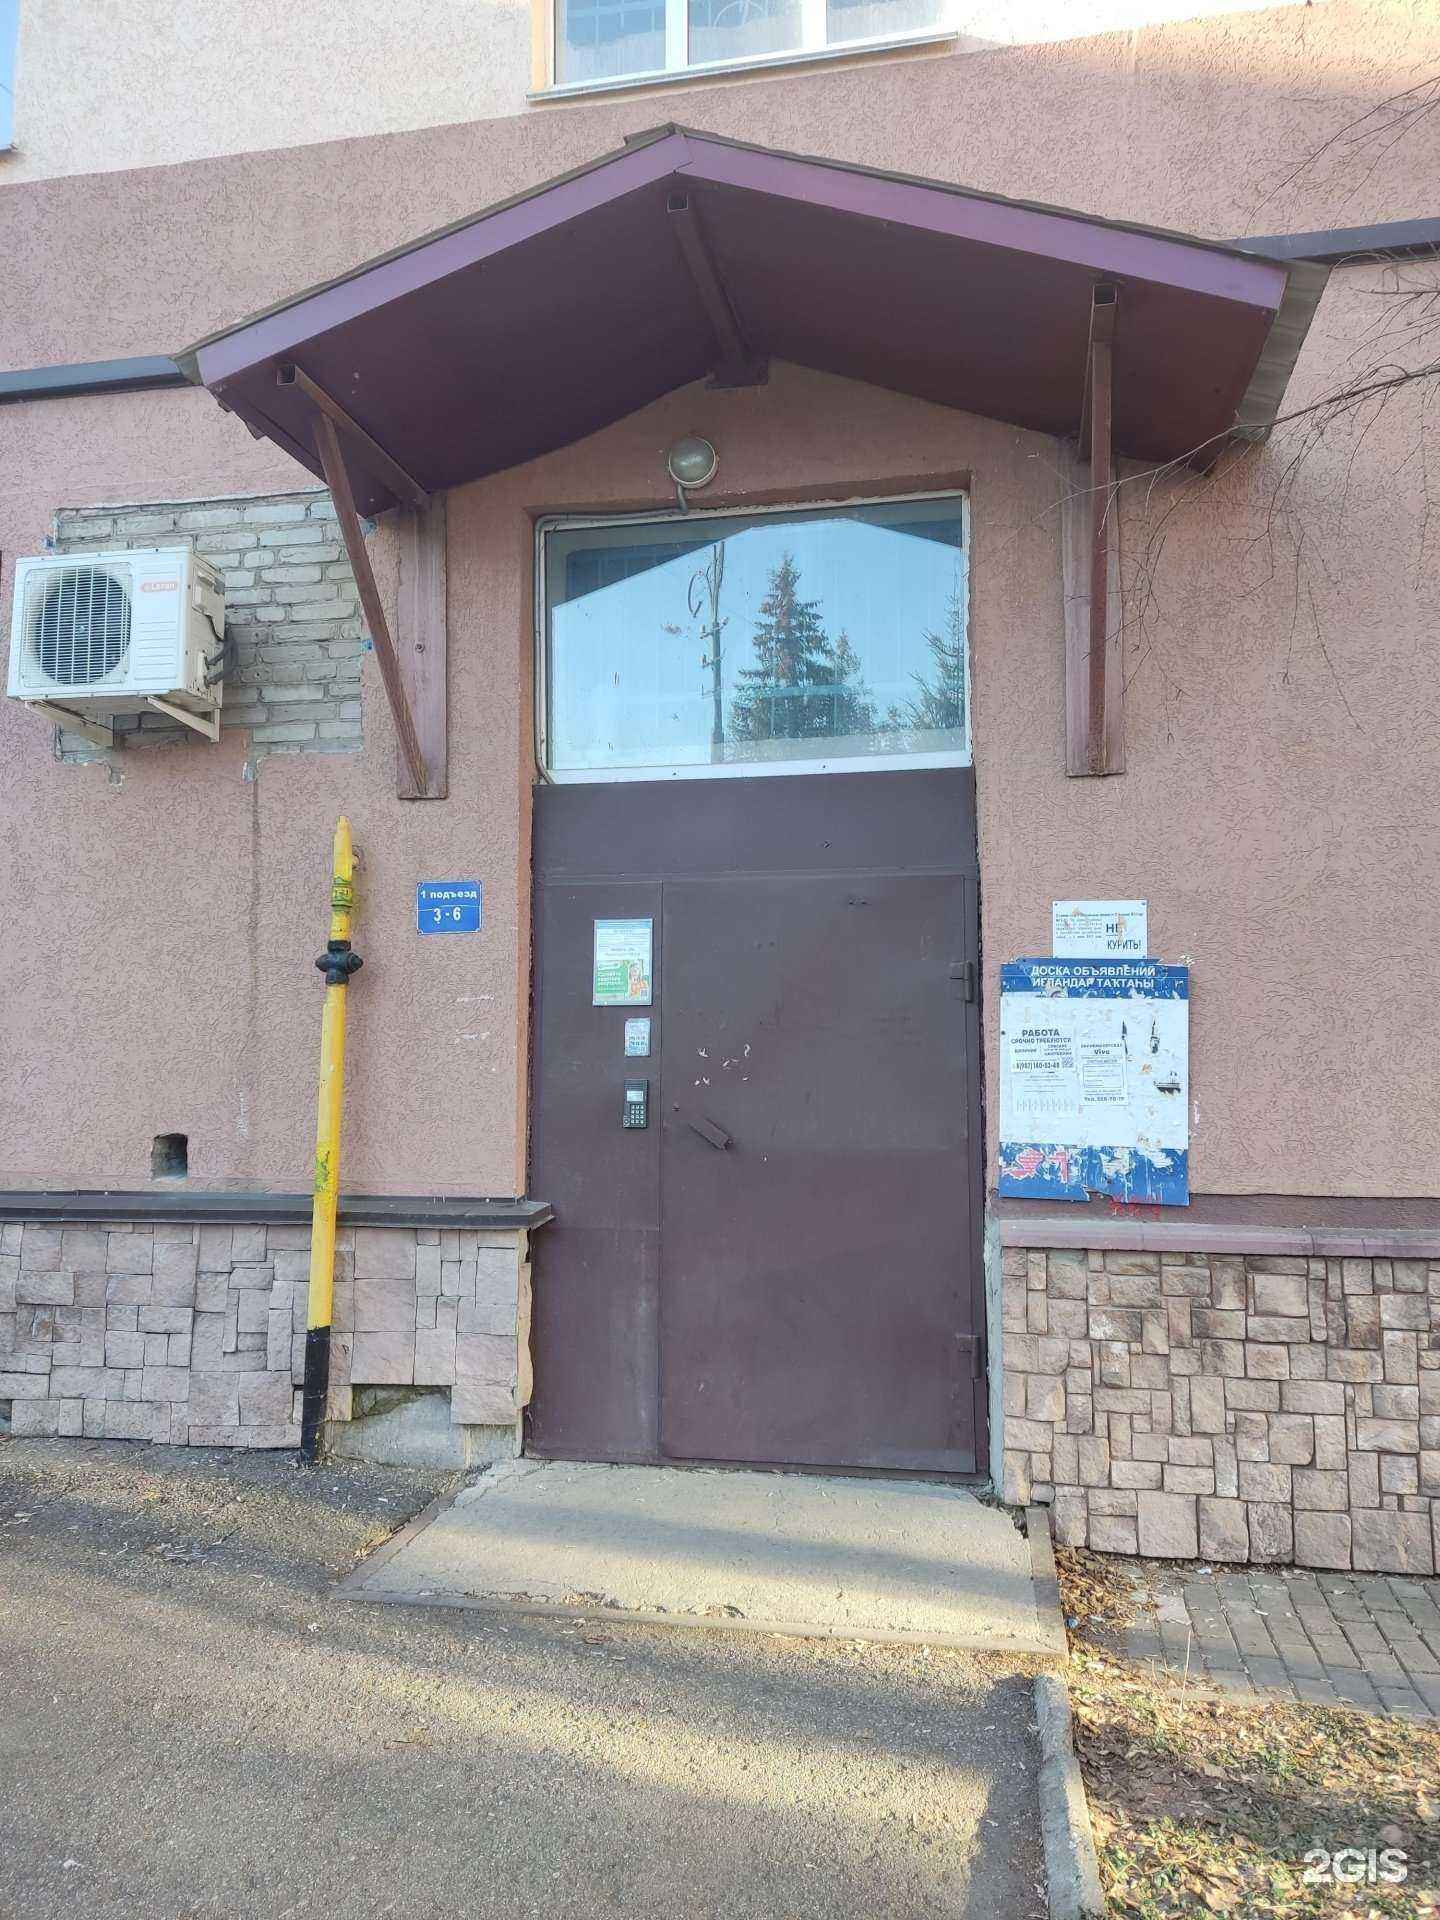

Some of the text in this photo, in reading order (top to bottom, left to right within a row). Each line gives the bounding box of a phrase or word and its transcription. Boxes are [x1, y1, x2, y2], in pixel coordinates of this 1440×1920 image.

[421, 890, 477, 899] 1 подъезд
[433, 908, 441, 921] 3
[452, 907, 461, 921] 6
[1031, 965, 1156, 977] ДОСКА ОБЪЯВЛЕНИЙ
[1022, 1029, 1060, 1037] РАБОТА
